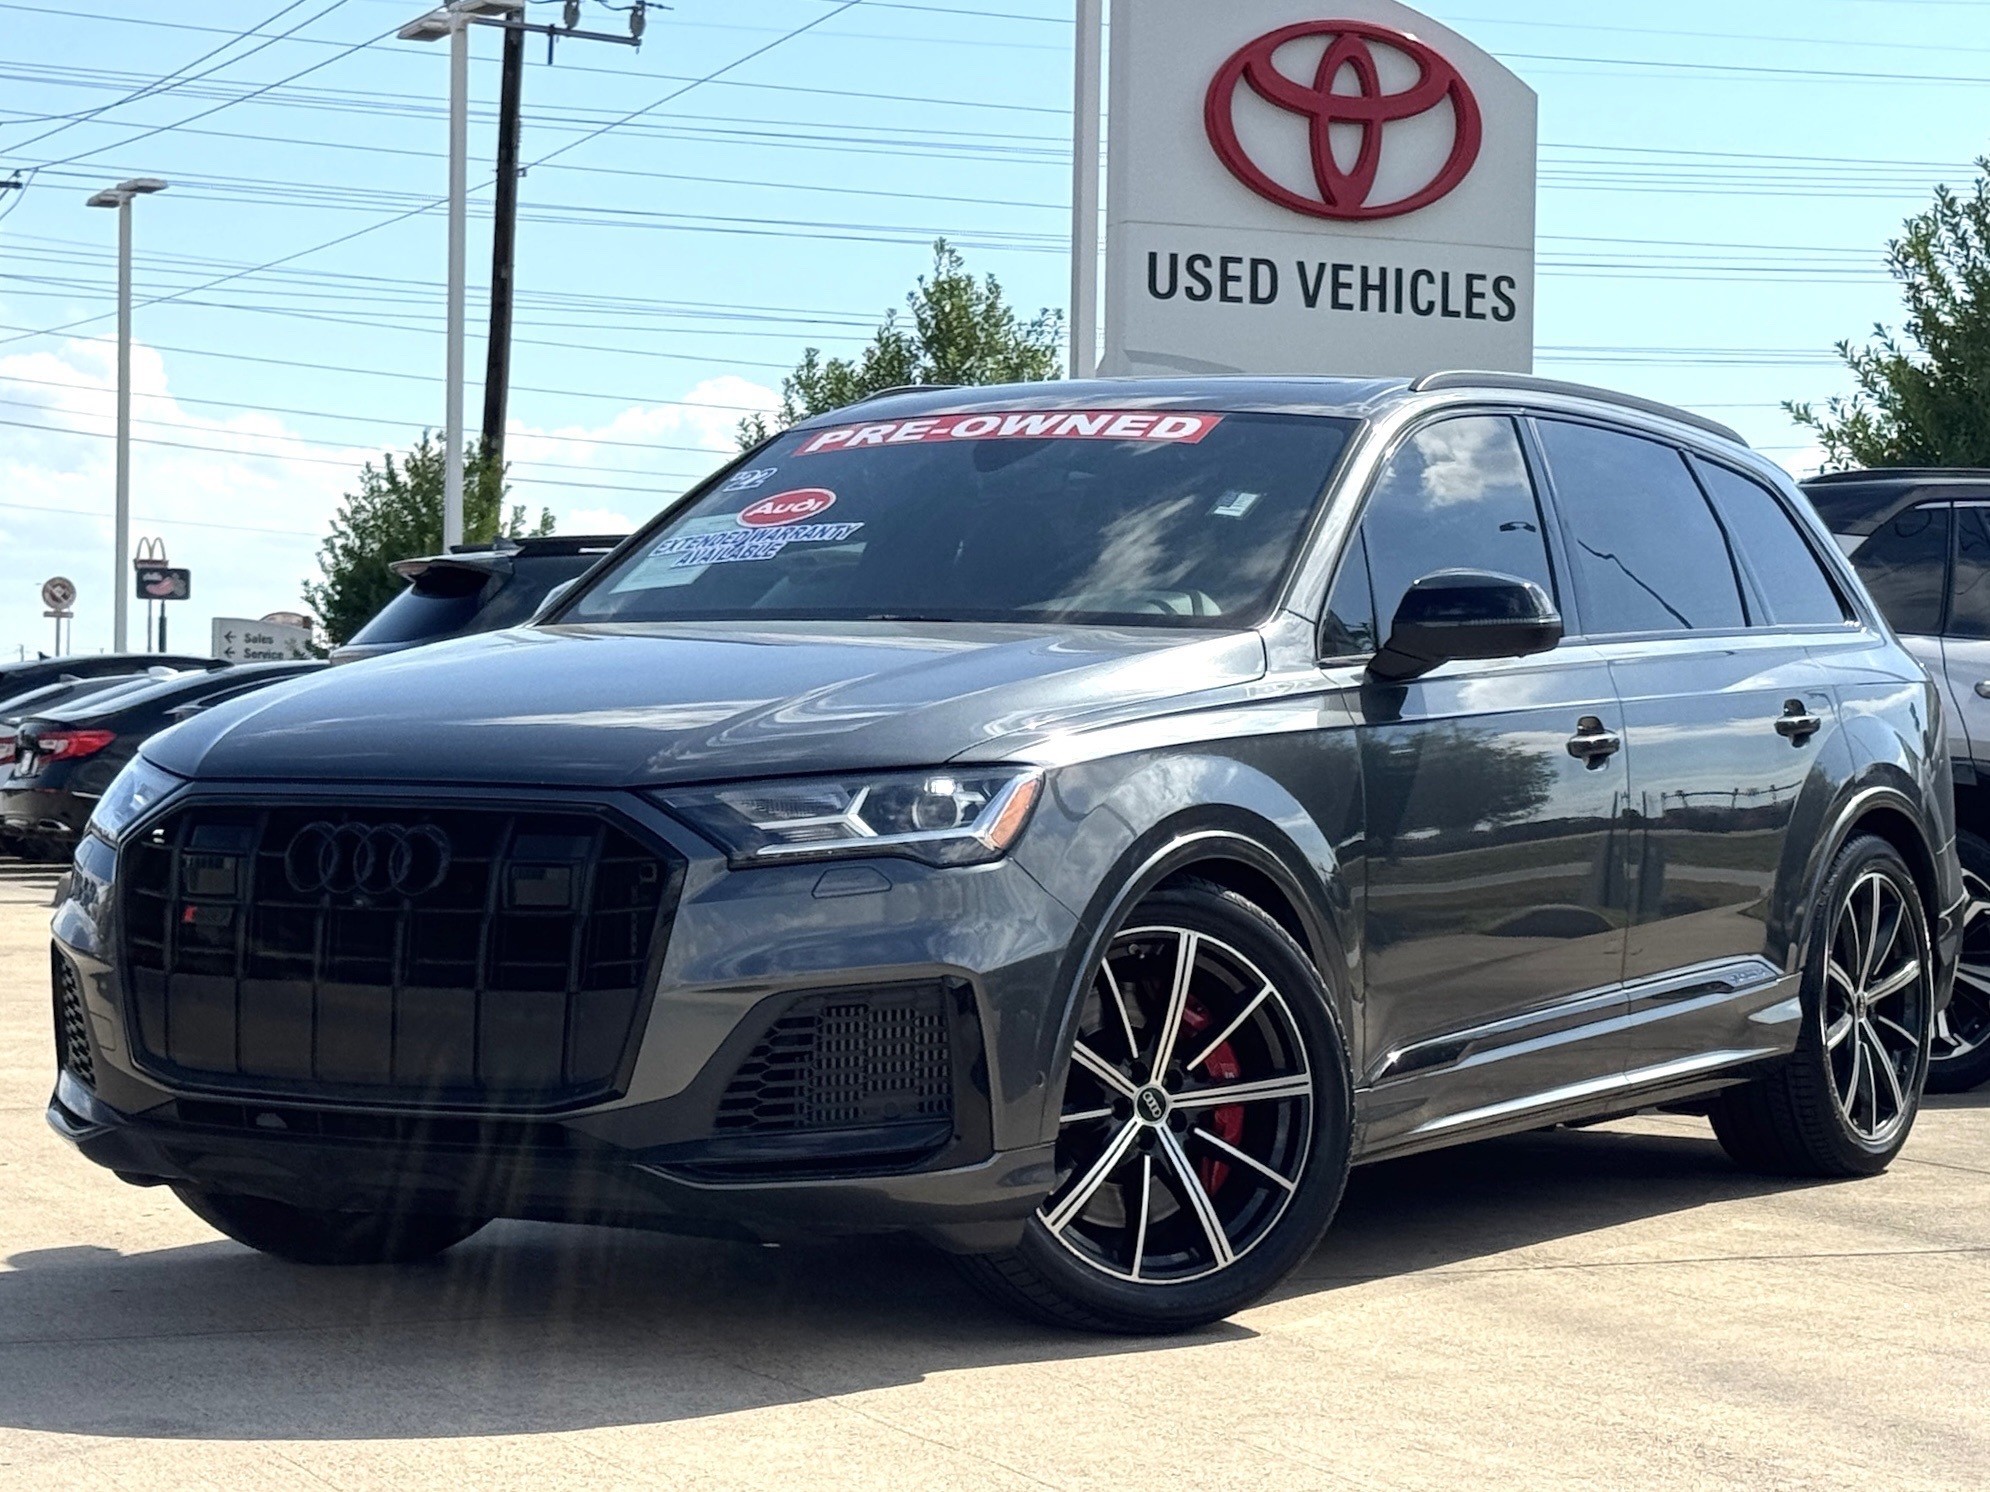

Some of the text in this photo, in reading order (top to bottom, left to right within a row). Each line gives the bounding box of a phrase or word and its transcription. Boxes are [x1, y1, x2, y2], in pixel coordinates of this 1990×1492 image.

[1147, 251, 1517, 322] USED VEHICLES
[800, 413, 1205, 454] PRE-OWNED
[748, 497, 823, 517] Audi
[655, 525, 860, 554] EXTENDED WARRANTY
[676, 543, 782, 565] AVAILABLE
[244, 632, 274, 645] Sales
[244, 647, 284, 660] Service
